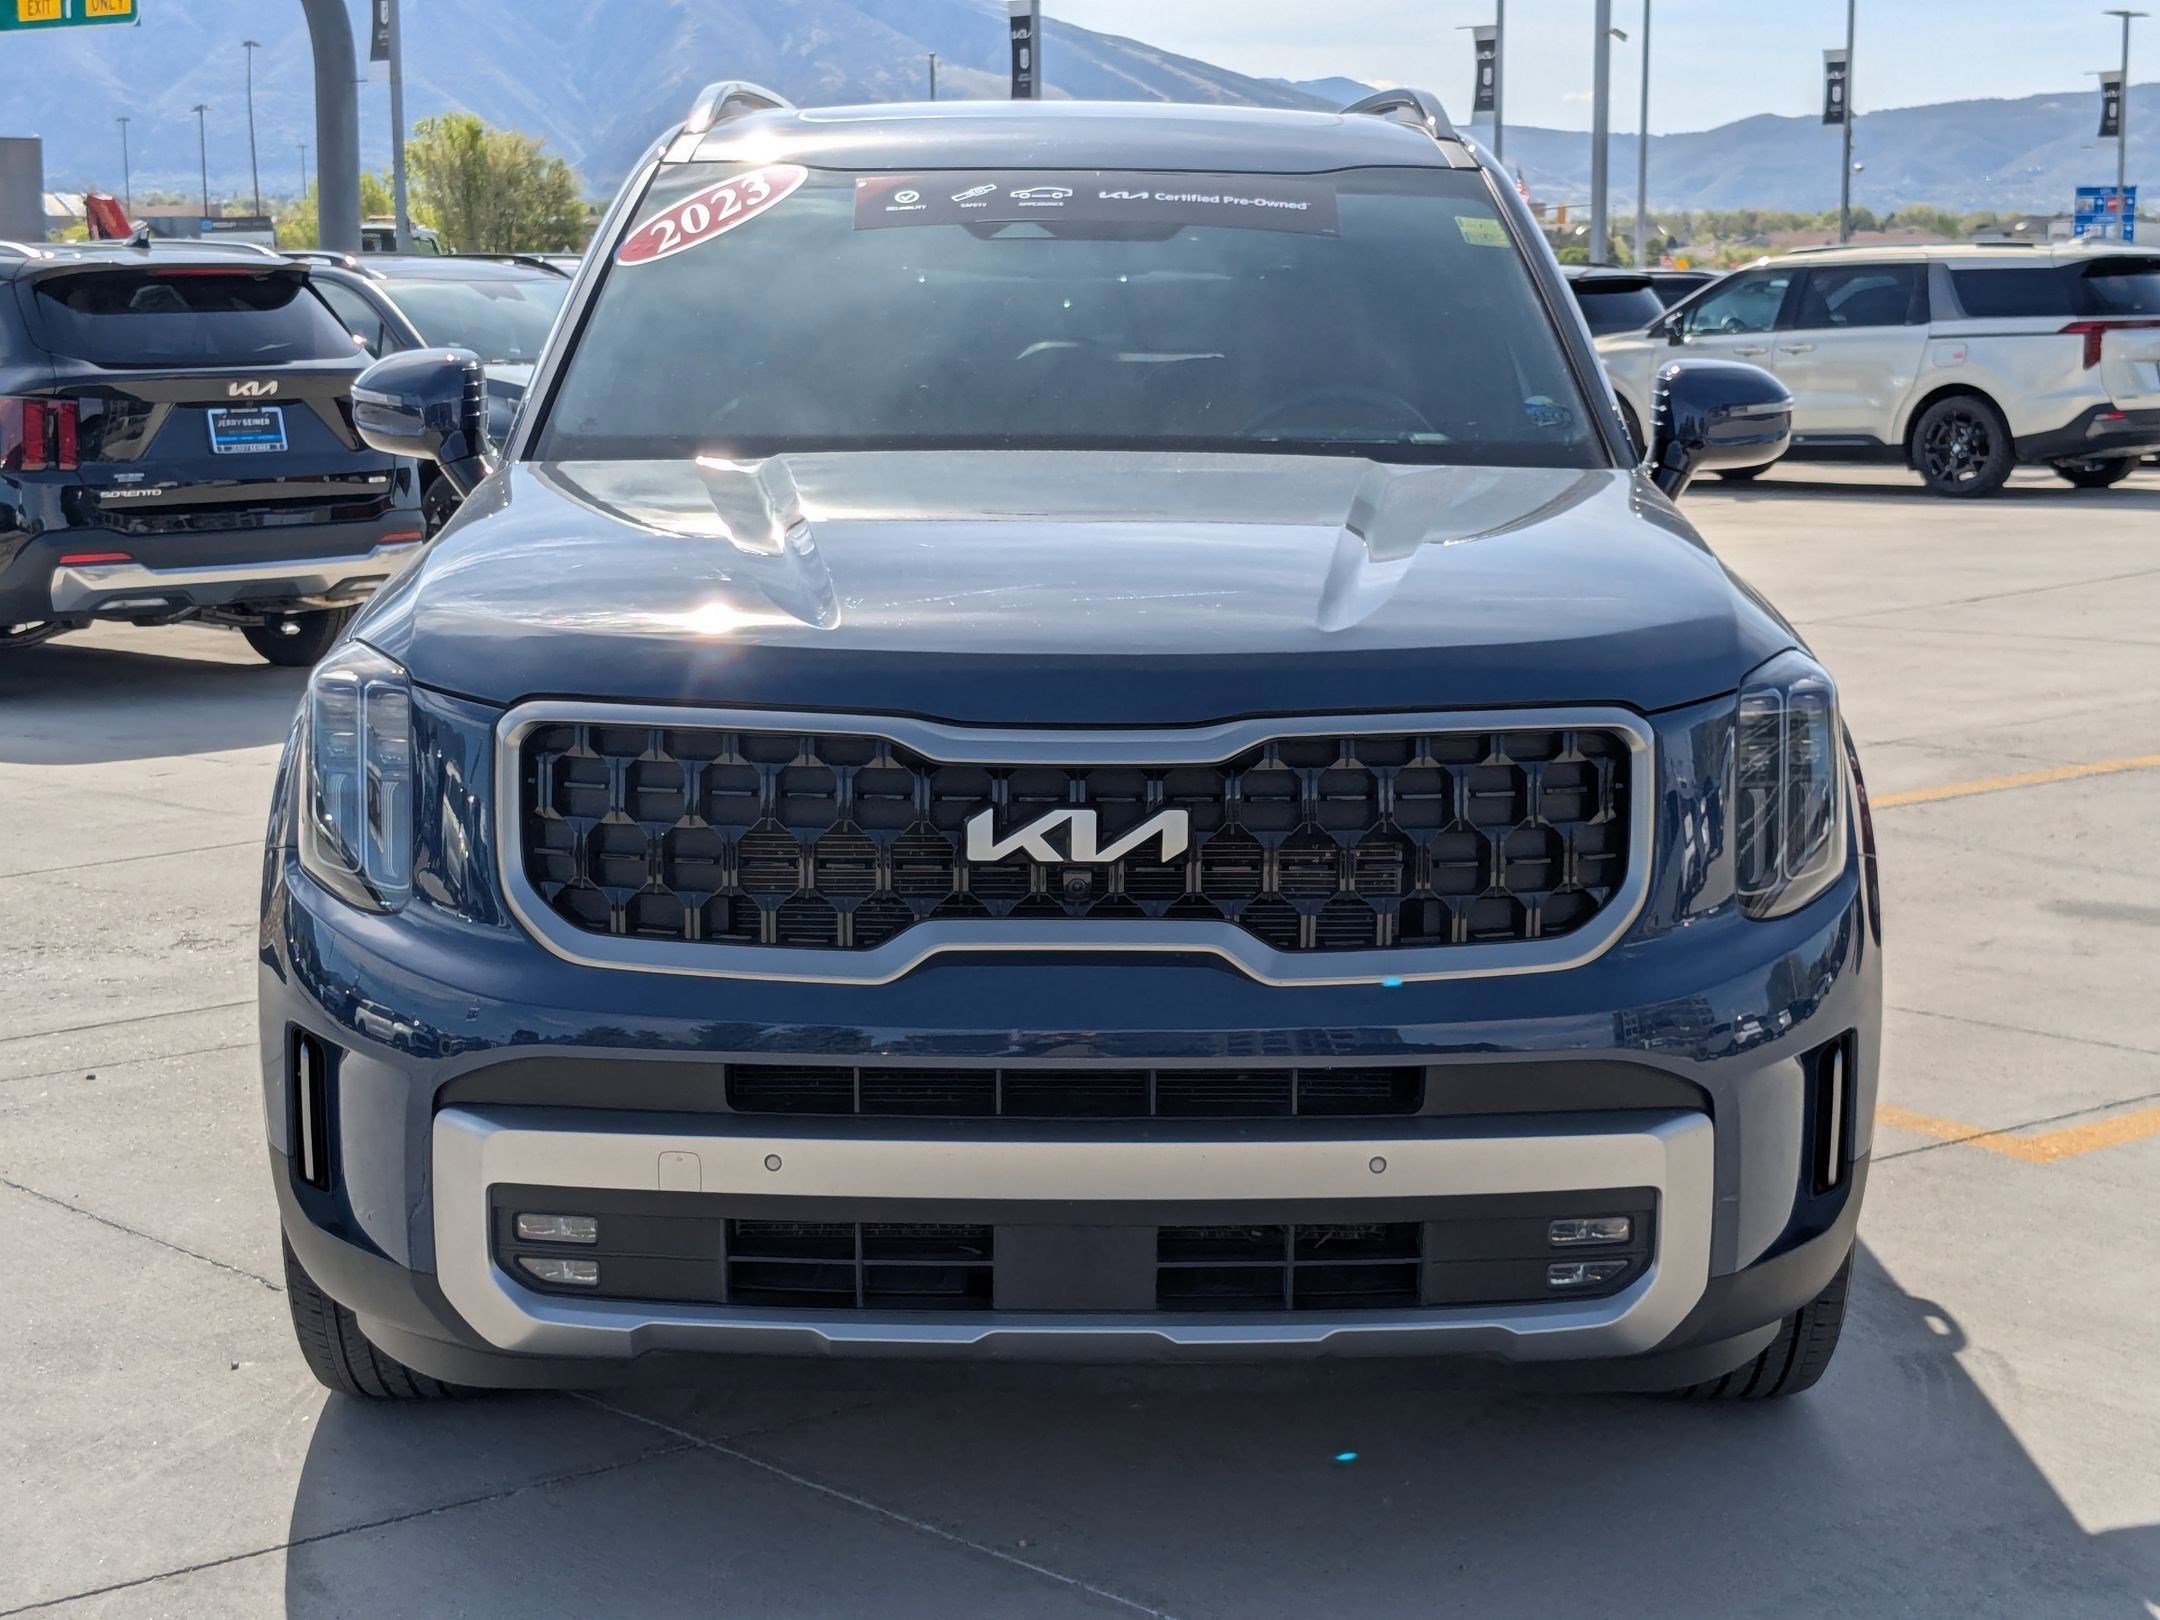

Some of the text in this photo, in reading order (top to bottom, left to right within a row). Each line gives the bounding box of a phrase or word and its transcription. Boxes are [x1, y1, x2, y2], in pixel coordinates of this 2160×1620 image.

[28, 0, 51, 16] EXIT
[91, 0, 124, 11] ONLY
[1099, 191, 1149, 199] KIA
[1155, 192, 1220, 204] Certified
[650, 173, 771, 253] 2023
[229, 381, 278, 396] KIA
[217, 418, 270, 427] JERRY SEINER
[100, 489, 162, 498] SORENTO
[967, 808, 1189, 863] KIA
